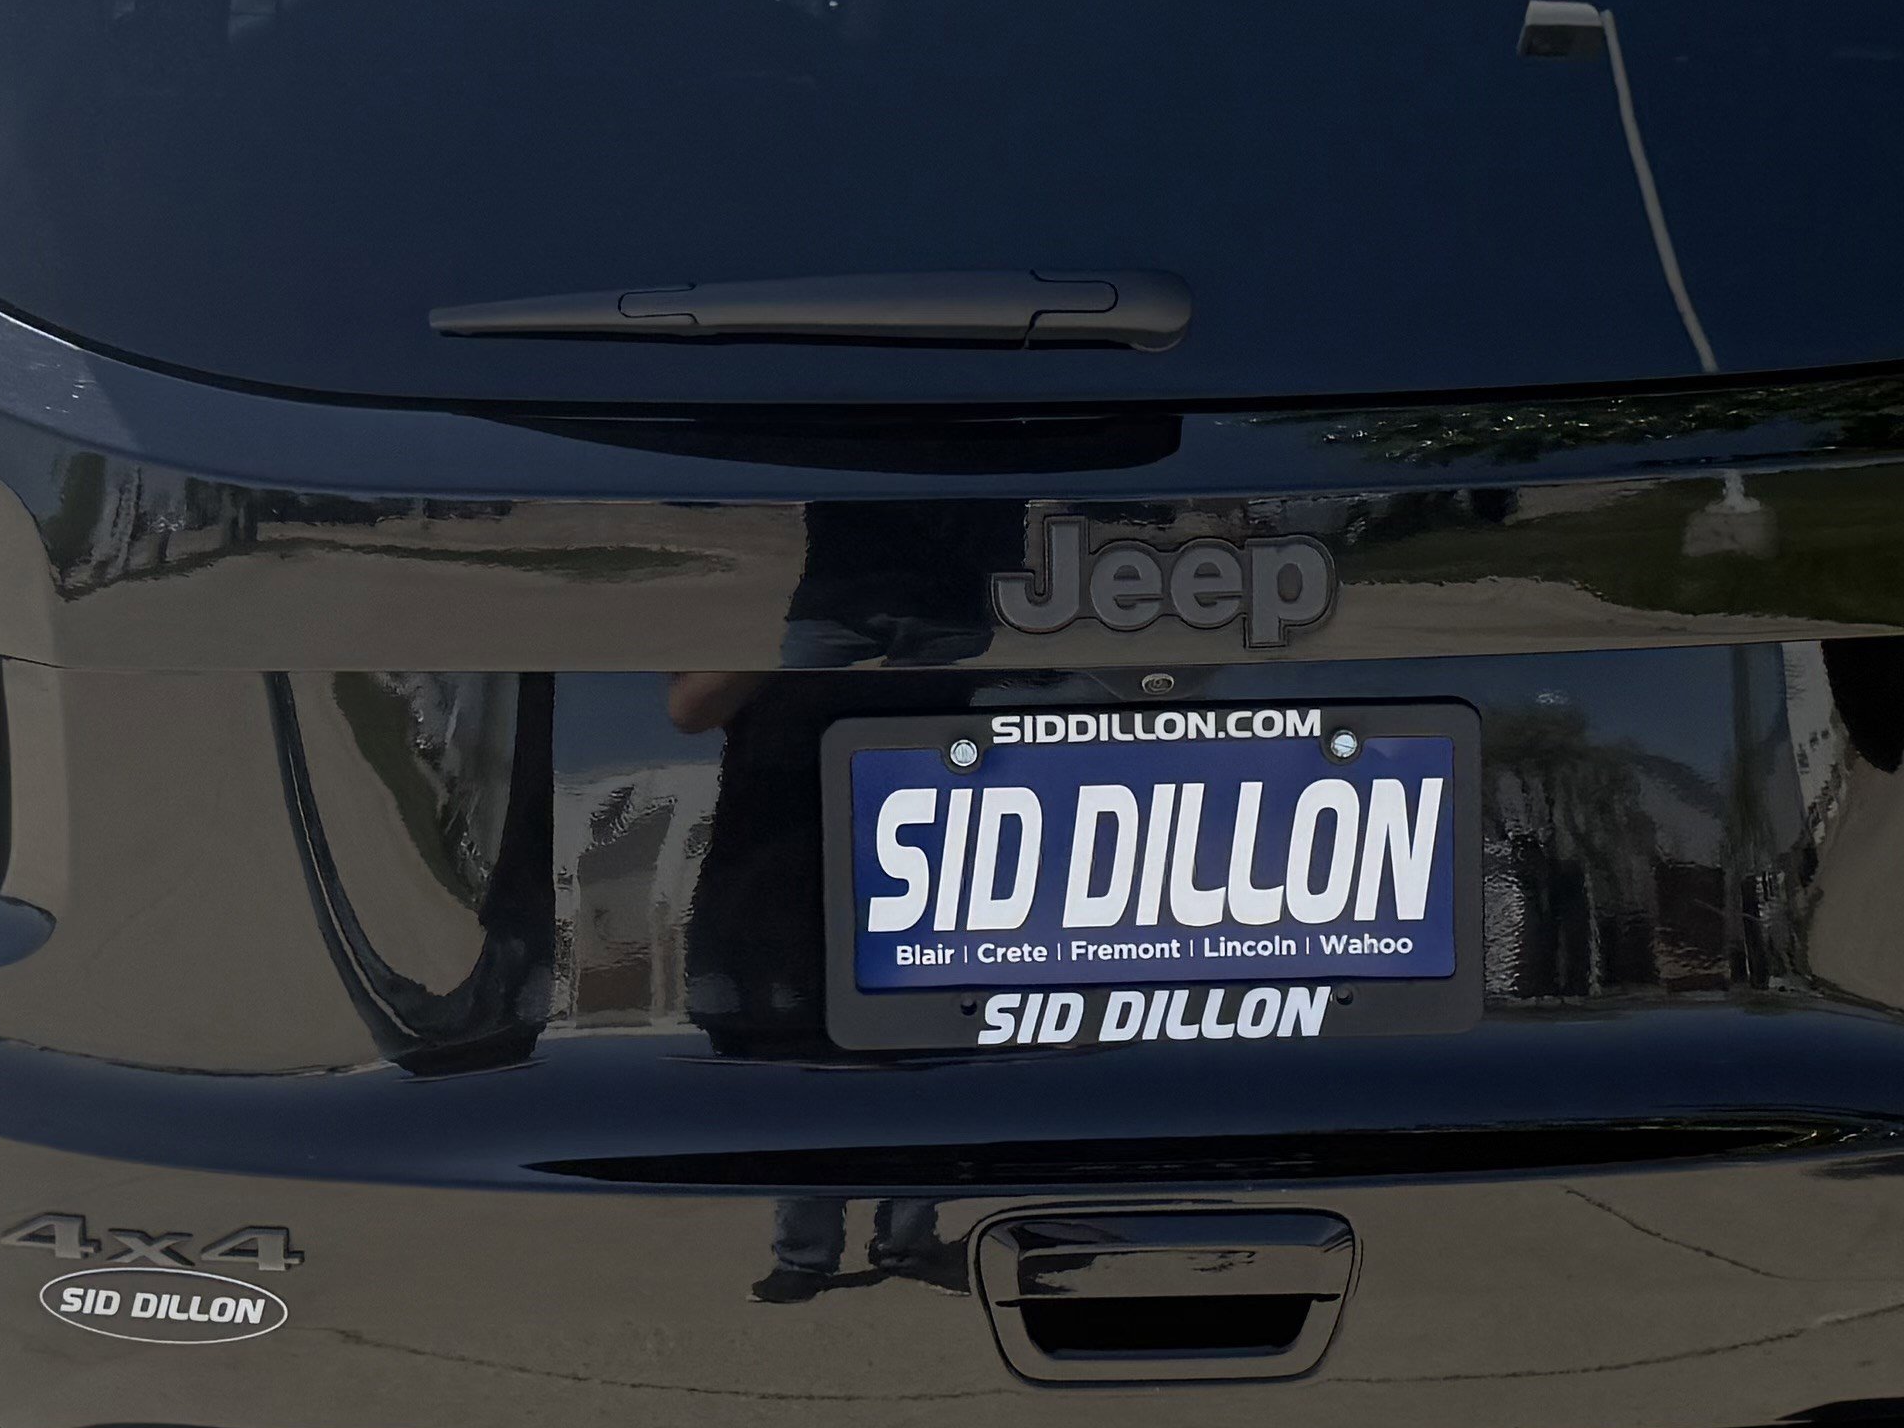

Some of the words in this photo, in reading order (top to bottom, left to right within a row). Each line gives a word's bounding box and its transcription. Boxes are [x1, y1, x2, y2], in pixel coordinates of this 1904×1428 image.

[992, 516, 1336, 648] Jeep
[990, 708, 1322, 744] SIDDILLON.COM
[867, 786, 1044, 933] SID
[1062, 777, 1444, 929] DILLON
[895, 942, 956, 967] Blair
[976, 941, 1049, 965] Crete
[1069, 936, 1182, 963] Fremont
[1202, 933, 1298, 959] Lincoln
[1318, 931, 1415, 956] Wahoo
[977, 990, 1085, 1045] SID
[1097, 985, 1332, 1043] DILLON
[60, 1287, 121, 1316] SID
[130, 1292, 266, 1325] DILLON
